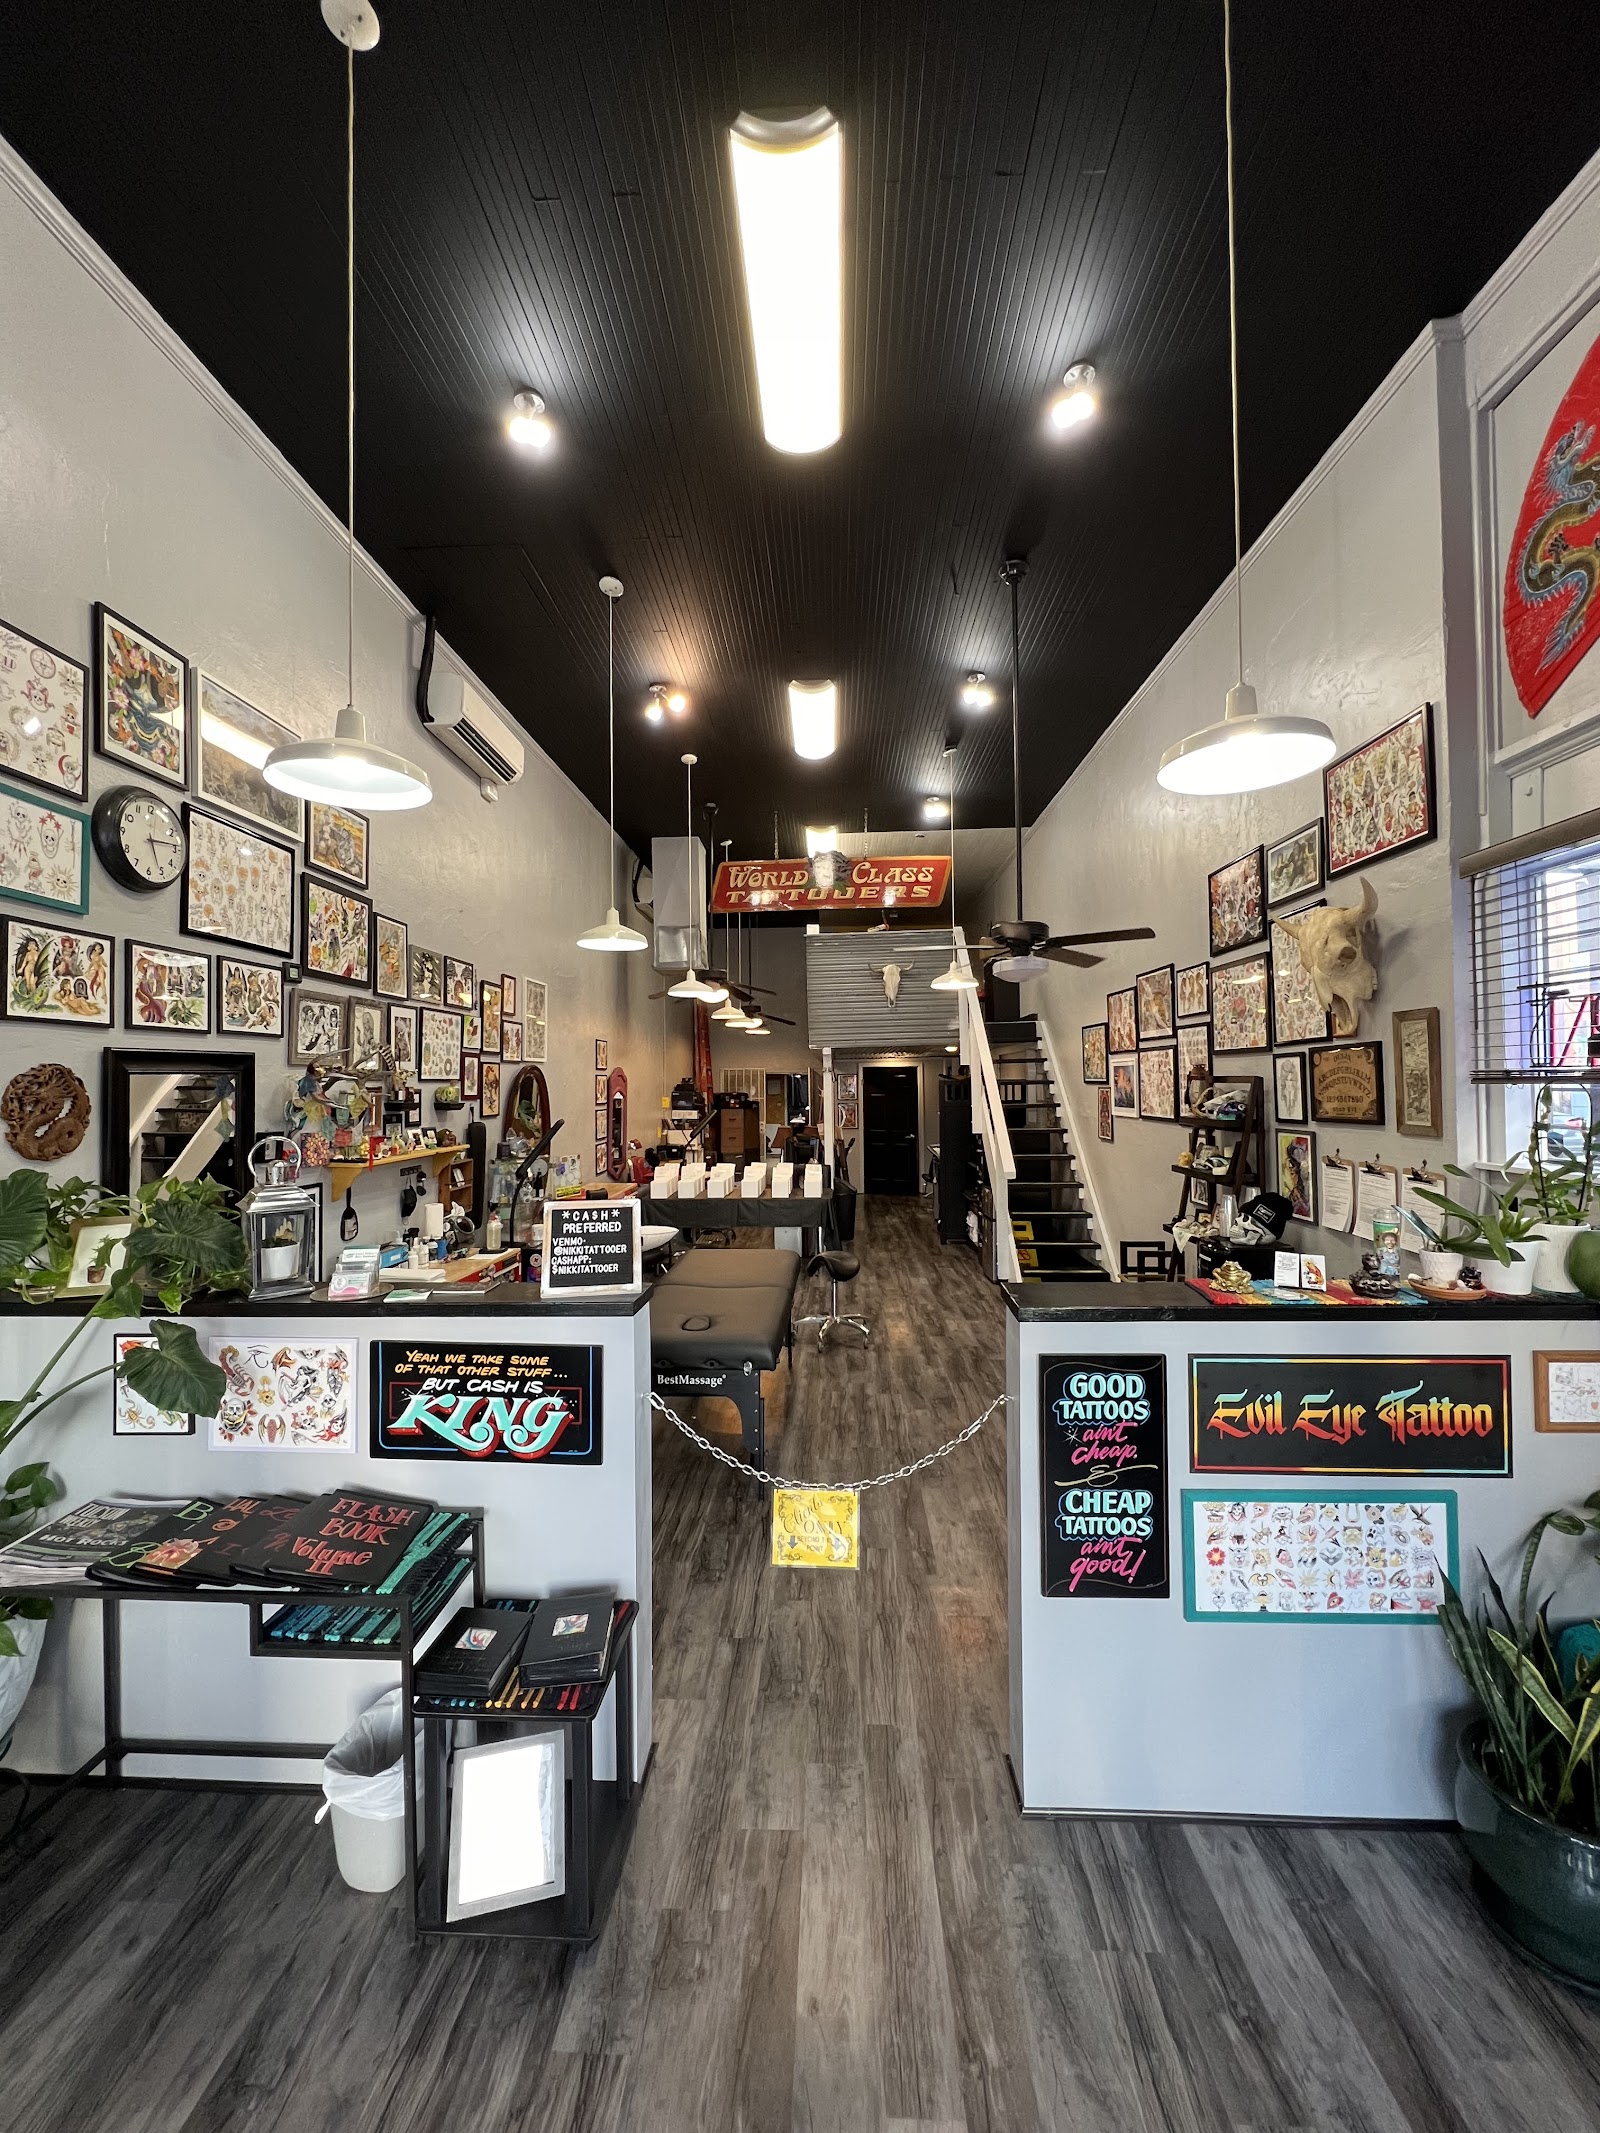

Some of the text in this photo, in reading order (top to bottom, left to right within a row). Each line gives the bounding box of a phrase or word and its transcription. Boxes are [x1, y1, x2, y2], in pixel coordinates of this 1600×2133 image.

[124, 813, 134, 823] 10
[147, 805, 155, 815] 12
[120, 826, 126, 836] 9
[124, 843, 130, 854] 8
[134, 857, 139, 867] 7
[168, 858, 173, 868] 4
[146, 866, 152, 876] 6
[158, 866, 164, 876] 5
[728, 861, 935, 889] WORLD CLASS
[562, 1221, 622, 1234] PREFERRED
[553, 1244, 628, 1256] @NIKKITATTOOER
[405, 1349, 550, 1366] YEAH WE TAKE SOME
[394, 1363, 415, 1374] OF
[417, 1364, 453, 1375] THAT
[457, 1365, 500, 1376] OTHER
[422, 1377, 544, 1394] BUT CASH IS
[1069, 1374, 1144, 1399] GOOD
[1059, 1400, 1149, 1420] TATTOOS
[1206, 1380, 1494, 1445] Evil Eye Tattoo
[387, 1393, 573, 1458] KING
[1065, 1490, 1152, 1515] CHEAP
[328, 1497, 420, 1526] FLASH
[318, 1517, 398, 1546] BOOK
[1061, 1516, 1153, 1537] TATTOOS
[291, 1536, 373, 1566] Volume
